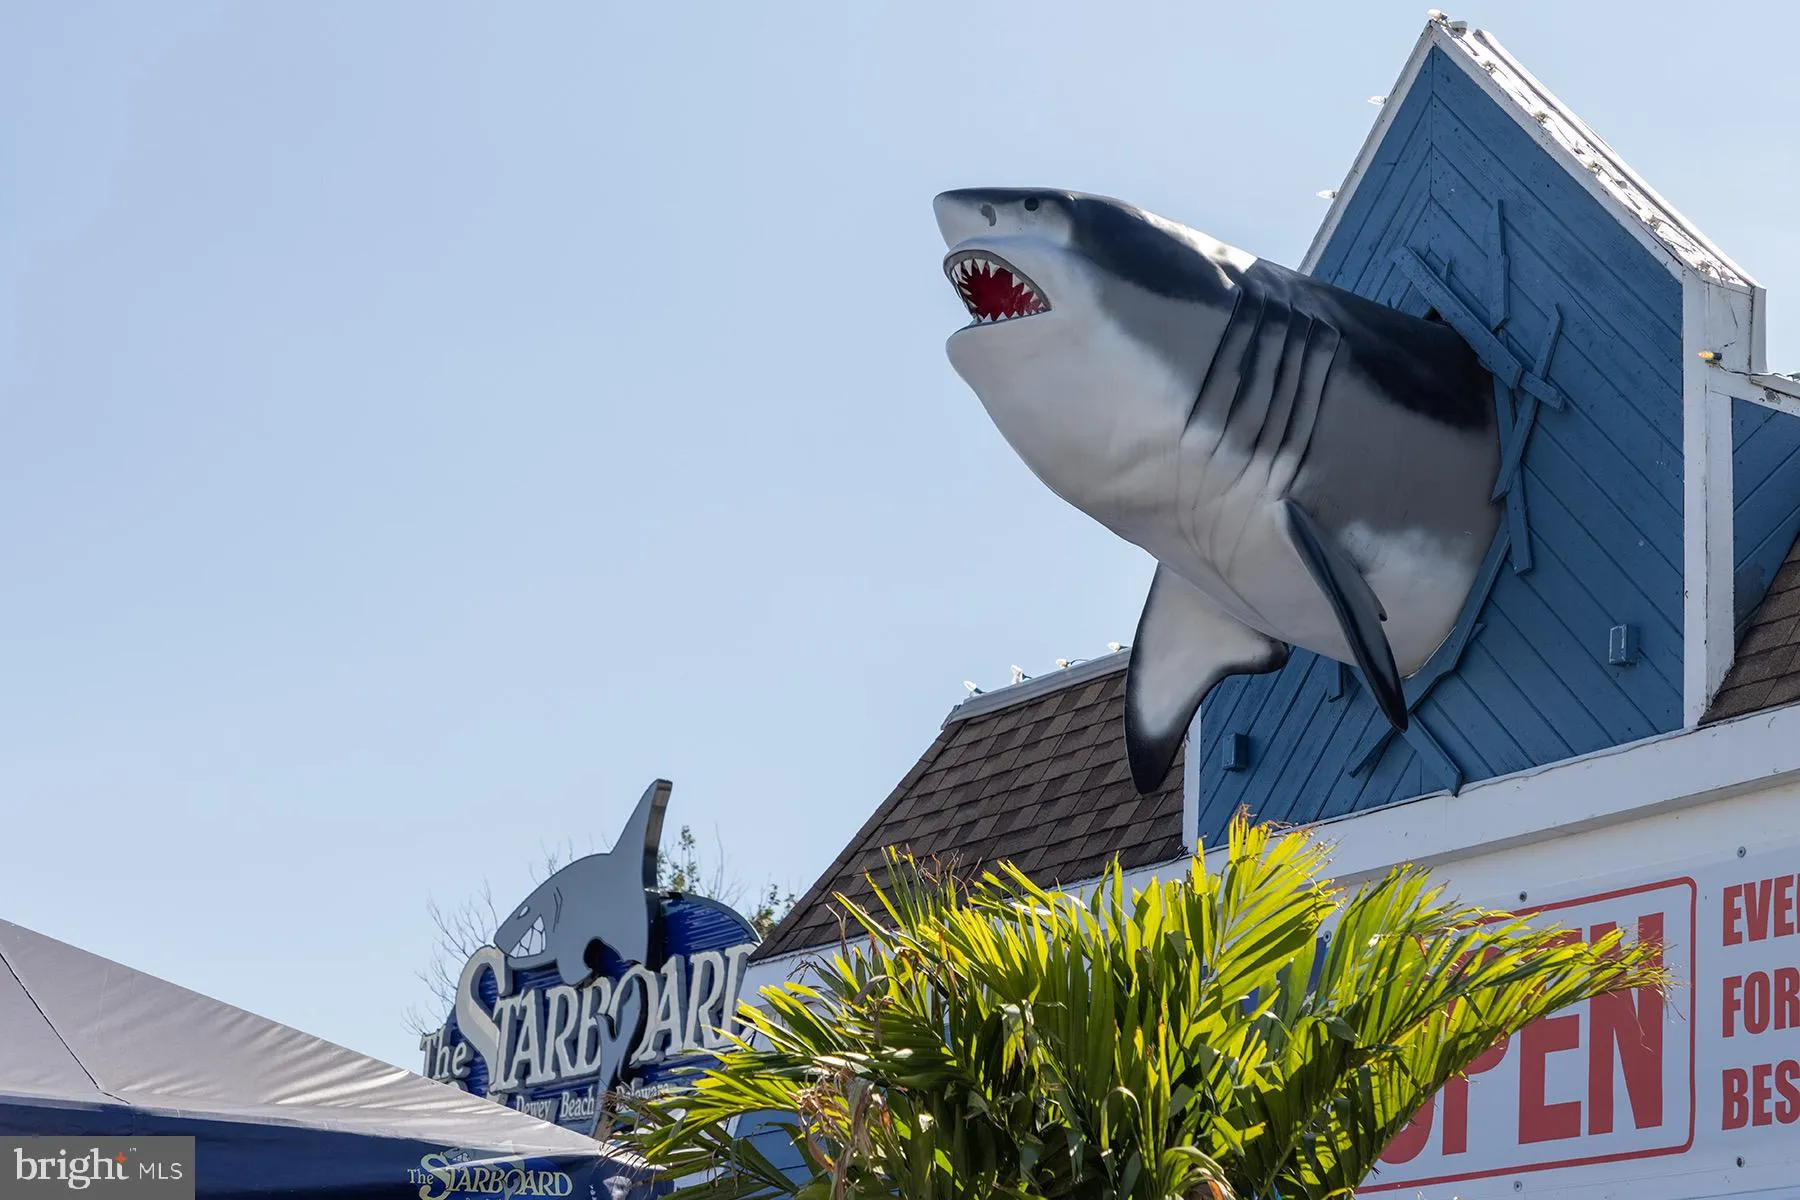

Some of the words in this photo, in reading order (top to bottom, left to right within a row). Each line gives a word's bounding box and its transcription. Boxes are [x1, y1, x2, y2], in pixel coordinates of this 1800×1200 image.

[1723, 873, 1800, 947] EVE
[1722, 967, 1800, 1038] FOR
[421, 1024, 468, 1081] The
[1377, 912, 1664, 1165] PEN
[559, 1085, 595, 1118] Beach
[407, 1168, 434, 1184] The
[418, 1152, 573, 1200] STARBOARD
